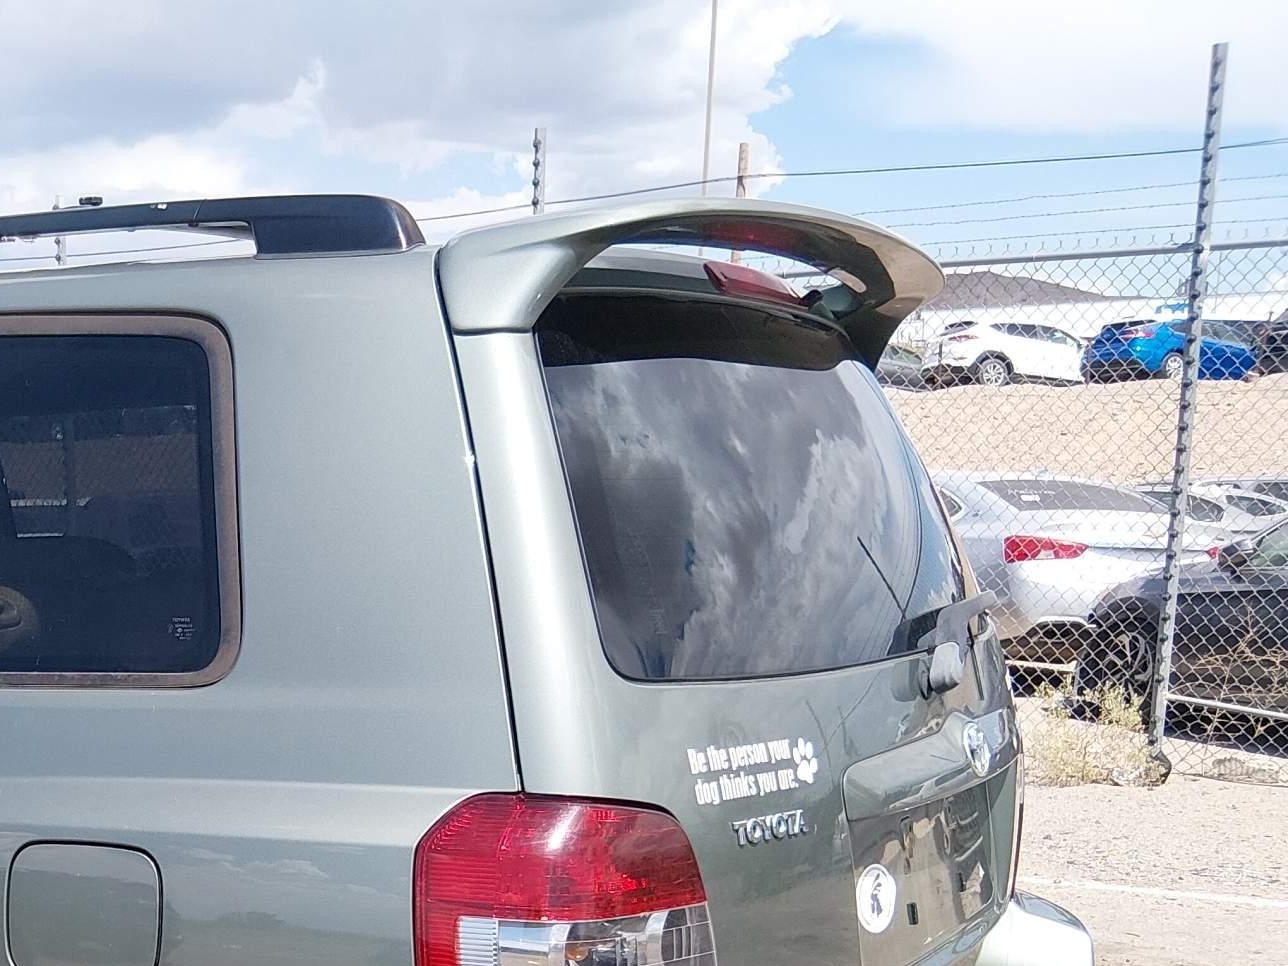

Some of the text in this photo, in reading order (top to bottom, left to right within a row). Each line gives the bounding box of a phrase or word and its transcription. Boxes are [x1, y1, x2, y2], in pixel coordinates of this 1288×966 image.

[687, 739, 791, 775] Be the person your
[695, 778, 720, 805] dog
[718, 771, 757, 801] thinks
[756, 771, 779, 797] you
[730, 809, 810, 847] TOYOTA
